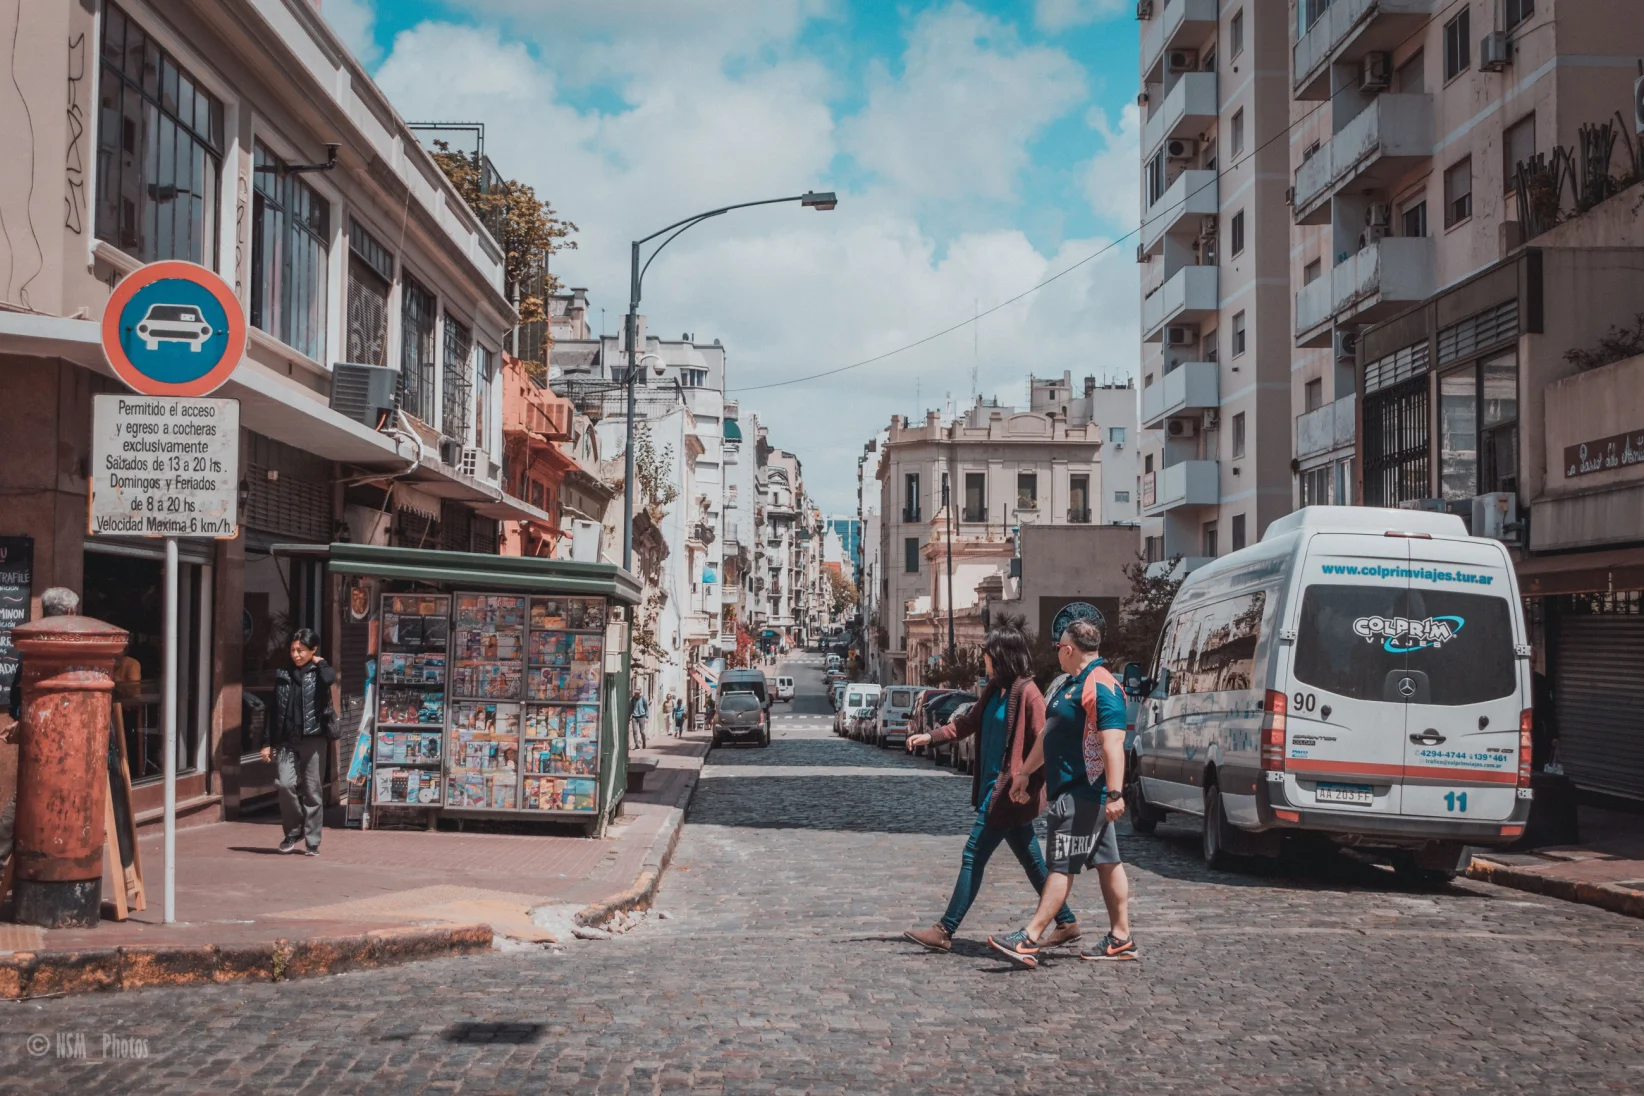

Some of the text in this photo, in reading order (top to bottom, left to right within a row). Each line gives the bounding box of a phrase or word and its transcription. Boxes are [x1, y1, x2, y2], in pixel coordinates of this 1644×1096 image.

[118, 399, 216, 418] Permitido el acceso
[116, 421, 217, 439] y egreso a cocheras
[122, 437, 209, 453] exclusivamente
[152, 456, 165, 473] de
[168, 456, 181, 473] 13
[183, 462, 190, 473] a
[193, 456, 206, 473] 20
[110, 473, 216, 494] Domingos y Feriados
[130, 496, 143, 511] de
[146, 496, 154, 512] 8
[157, 500, 164, 512] a
[166, 496, 181, 512] 20
[96, 515, 144, 532] Velocidad
[146, 516, 187, 533] Maxima
[190, 517, 198, 533] 6
[1321, 563, 1494, 586] www.colprimviajes.tur.ar
[1353, 615, 1453, 643] COLPRIM
[1365, 637, 1442, 649] VIAJES
[1293, 692, 1317, 713] 90
[1420, 749, 1466, 760] 4294-4744
[1319, 788, 1332, 799] AA
[1335, 789, 1355, 800] 203
[1443, 791, 1468, 813] 11
